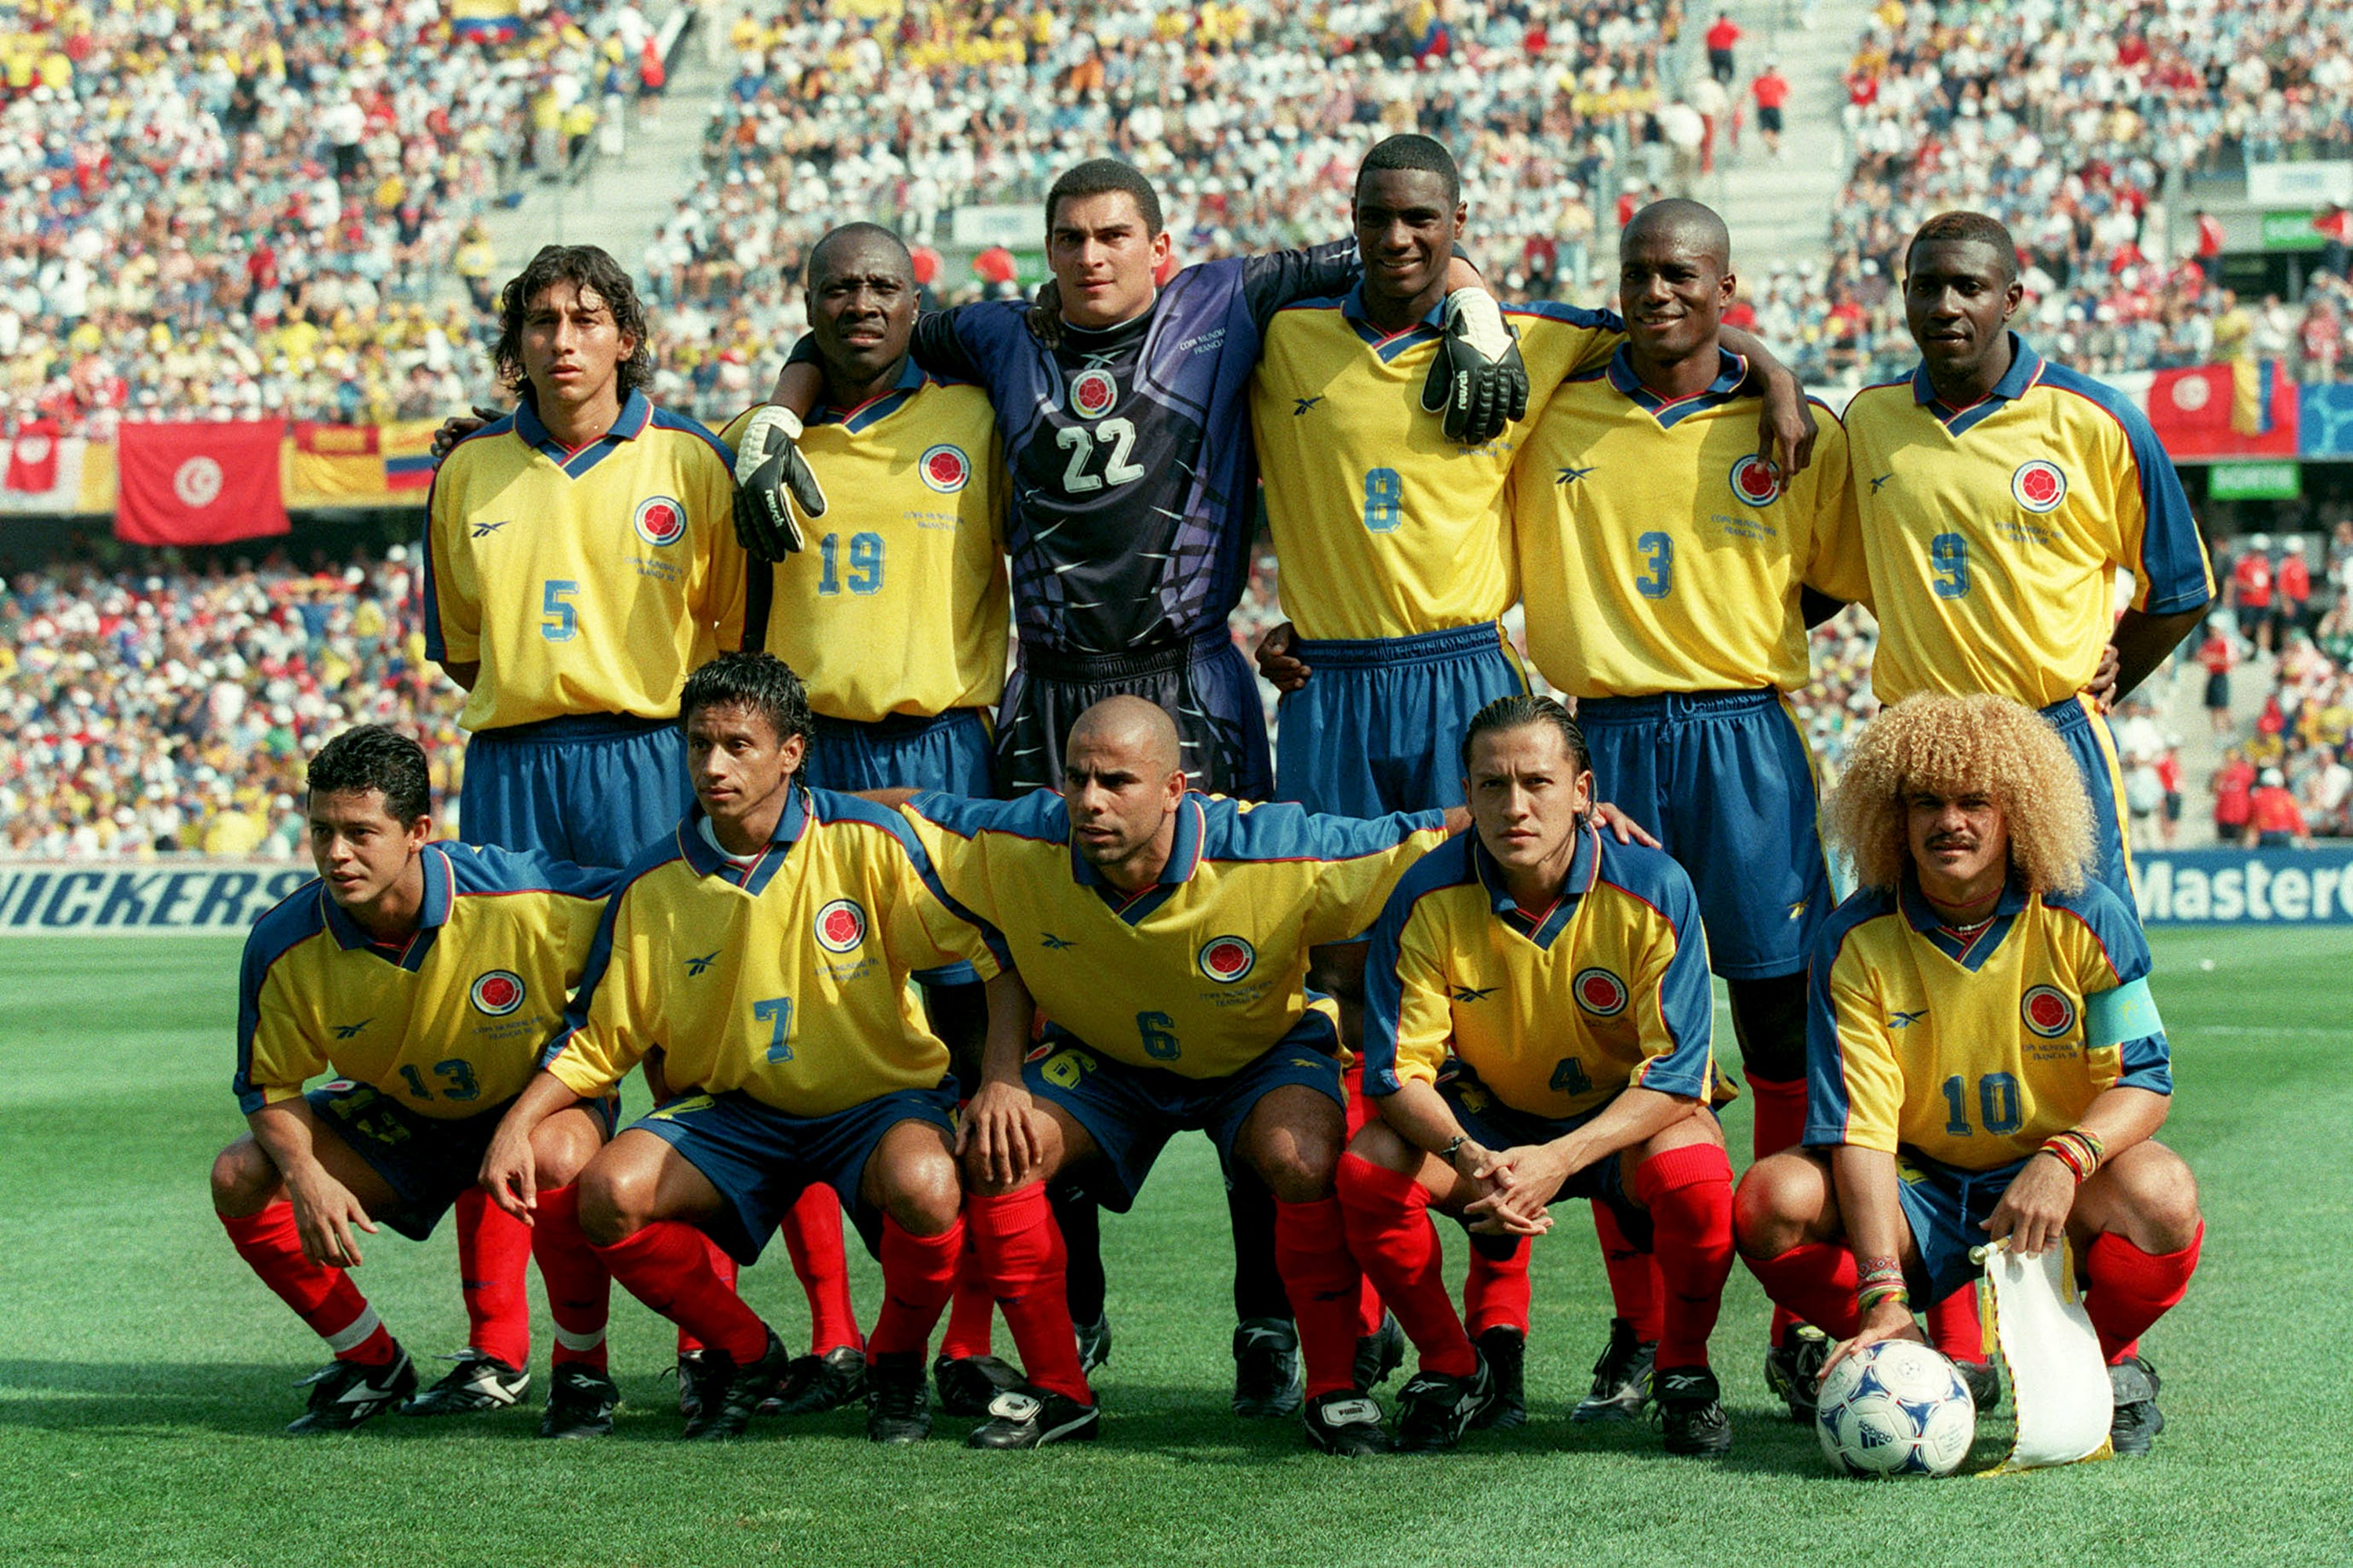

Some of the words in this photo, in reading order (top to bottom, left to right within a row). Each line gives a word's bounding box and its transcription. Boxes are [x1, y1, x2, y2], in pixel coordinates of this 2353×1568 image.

[1458, 369, 1468, 410] reusch
[1056, 417, 1145, 493] 22
[765, 489, 785, 528] reusch
[1364, 467, 1402, 534] 8
[818, 532, 886, 596] 19
[1636, 531, 1674, 598] 3
[1931, 532, 1970, 600] 9
[541, 580, 580, 642] 5
[753, 996, 795, 1064] 7
[1136, 1010, 1181, 1060] 6
[398, 1059, 480, 1101] 13
[1041, 1048, 1096, 1090] 6
[1550, 1056, 1593, 1096] 4
[1943, 1071, 2023, 1136] 10
[1857, 1420, 1893, 1443] adidas
